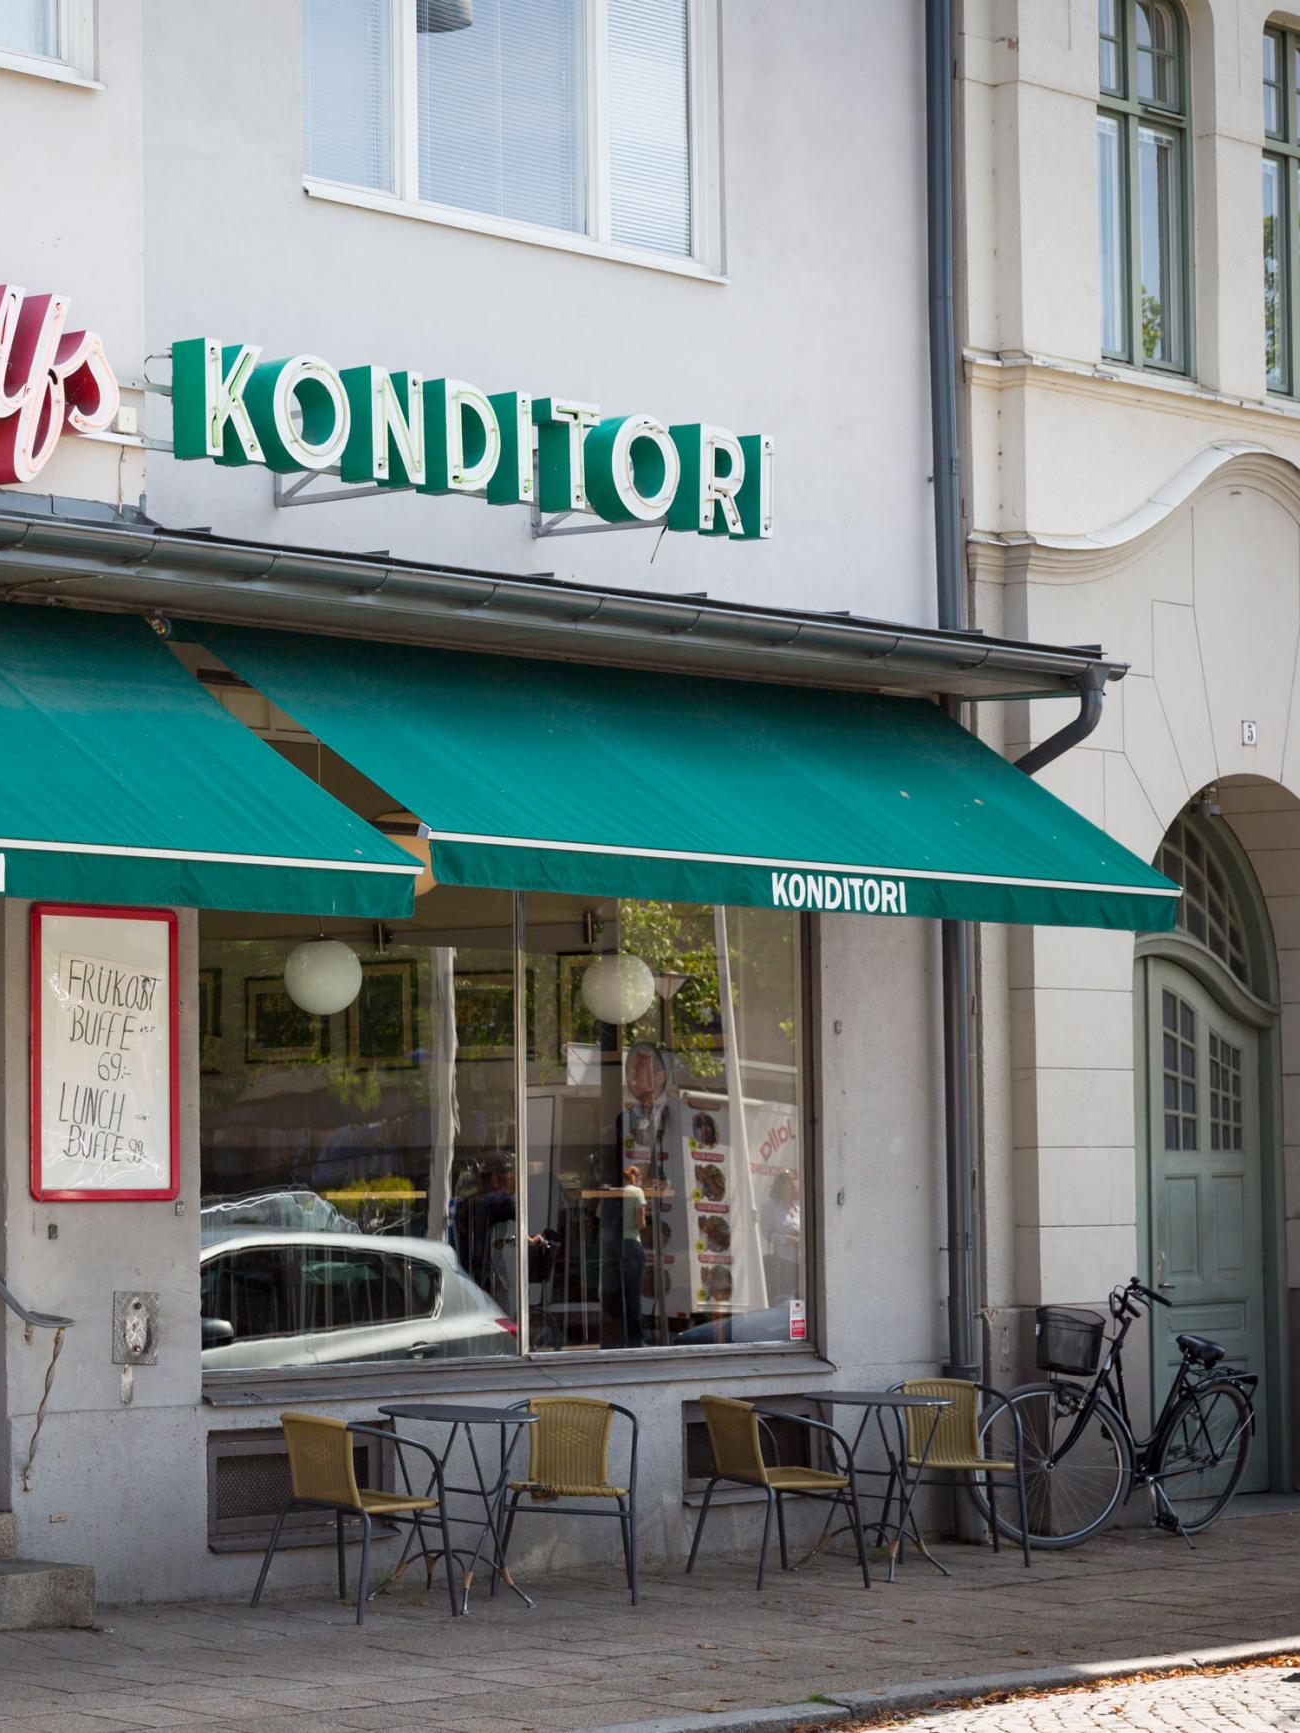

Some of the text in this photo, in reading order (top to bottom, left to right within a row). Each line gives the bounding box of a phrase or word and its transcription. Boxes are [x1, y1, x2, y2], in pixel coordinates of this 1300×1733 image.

[173, 338, 773, 540] KONDITORI
[771, 872, 907, 914] KONDITORI
[59, 1081, 126, 1132] LUNCH
